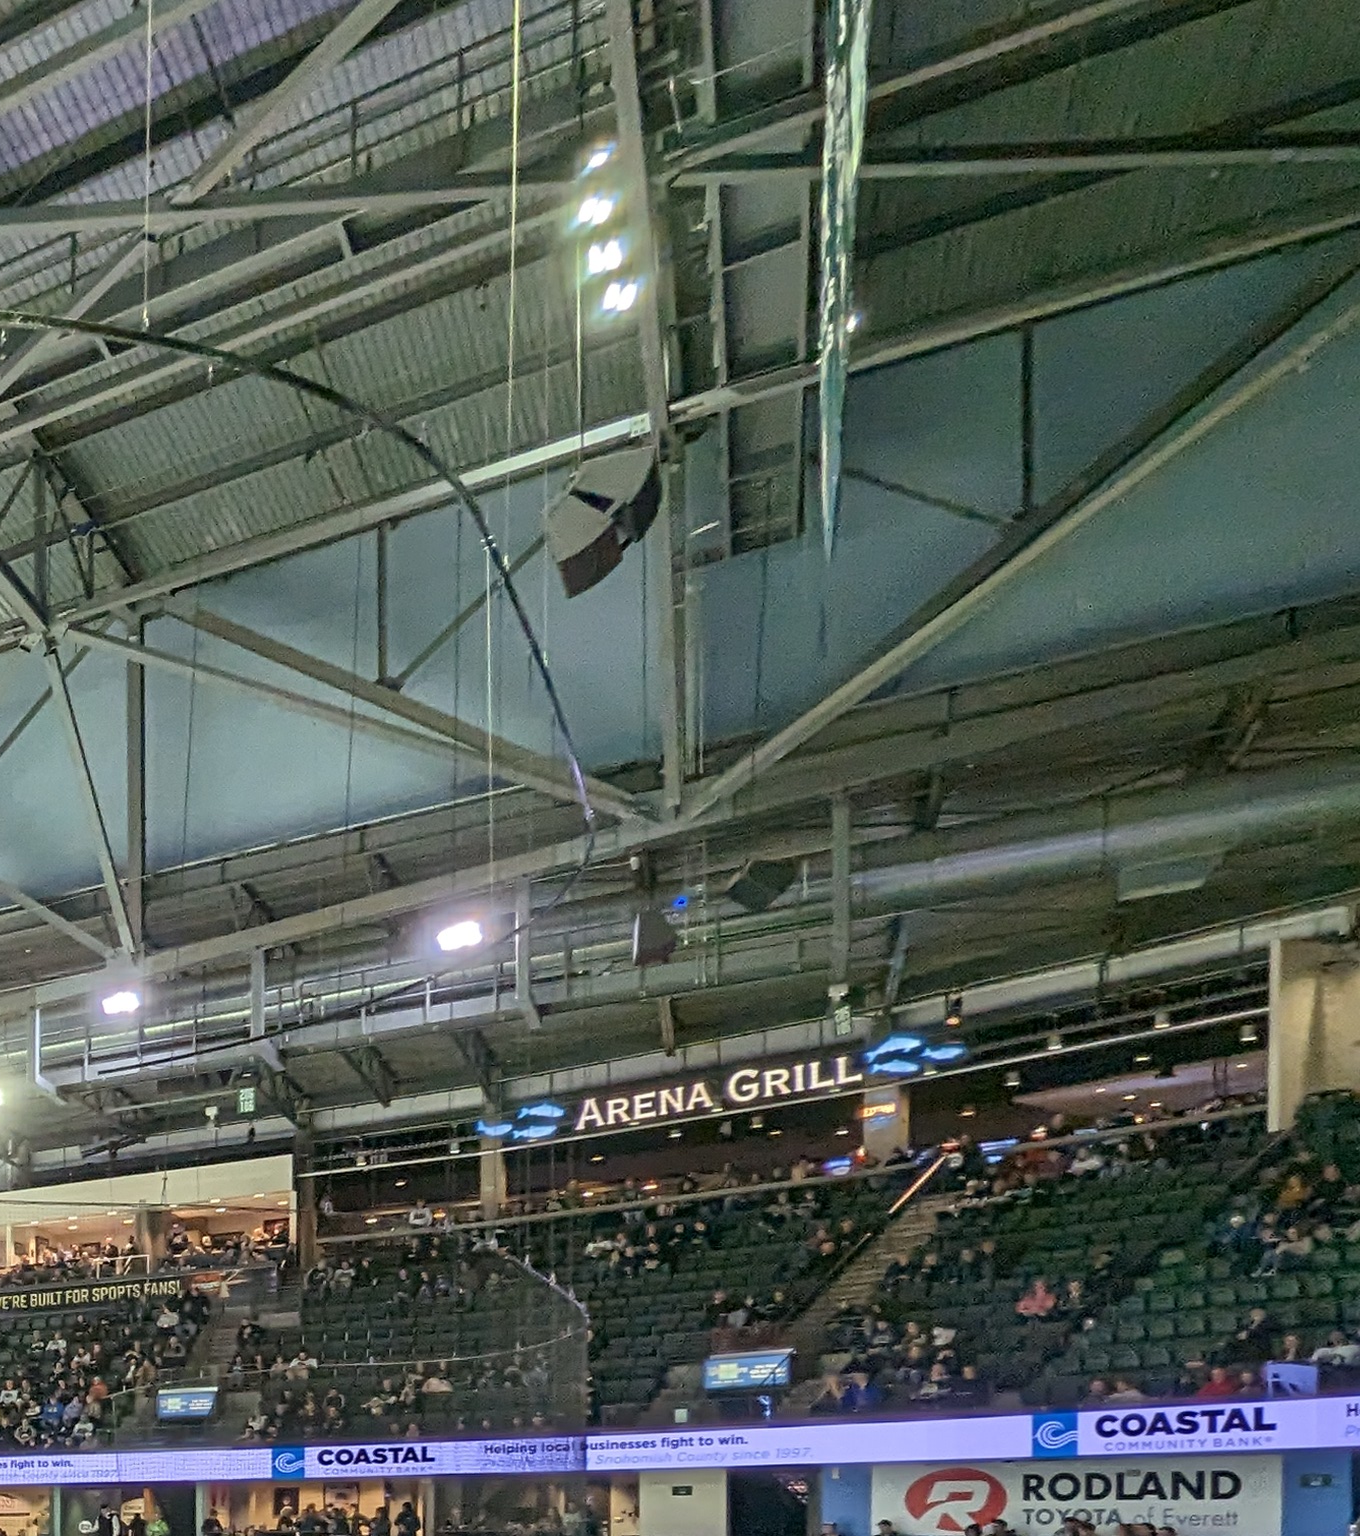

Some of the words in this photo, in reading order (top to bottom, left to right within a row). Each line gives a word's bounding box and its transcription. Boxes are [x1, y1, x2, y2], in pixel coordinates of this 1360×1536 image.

[575, 1082, 713, 1131] ARENA
[727, 1056, 863, 1102] GRILL
[30, 1292, 62, 1307] BUILT
[65, 1290, 89, 1305] FOR
[92, 1286, 140, 1302] SPORTS
[144, 1280, 180, 1298] FANS!
[1095, 1407, 1277, 1438] COASTAL
[317, 1446, 435, 1467] COASTAL
[484, 1443, 537, 1456] Helping
[541, 1440, 573, 1453] local
[580, 1437, 656, 1451] businesses
[660, 1436, 694, 1450] fight
[697, 1436, 714, 1446] to
[717, 1433, 748, 1446] win.
[1103, 1438, 1206, 1451] COMMUNITY
[10, 1460, 35, 1470] fight
[37, 1460, 49, 1468] to
[52, 1459, 73, 1468] win.
[595, 1451, 673, 1465] Snohomish
[676, 1449, 728, 1464] County
[732, 1448, 771, 1461] since
[324, 1465, 391, 1475] COMMUNITY
[1022, 1470, 1241, 1502] RODLAND
[1022, 1509, 1121, 1526] TOYOTA
[1164, 1509, 1239, 1527] Everett
